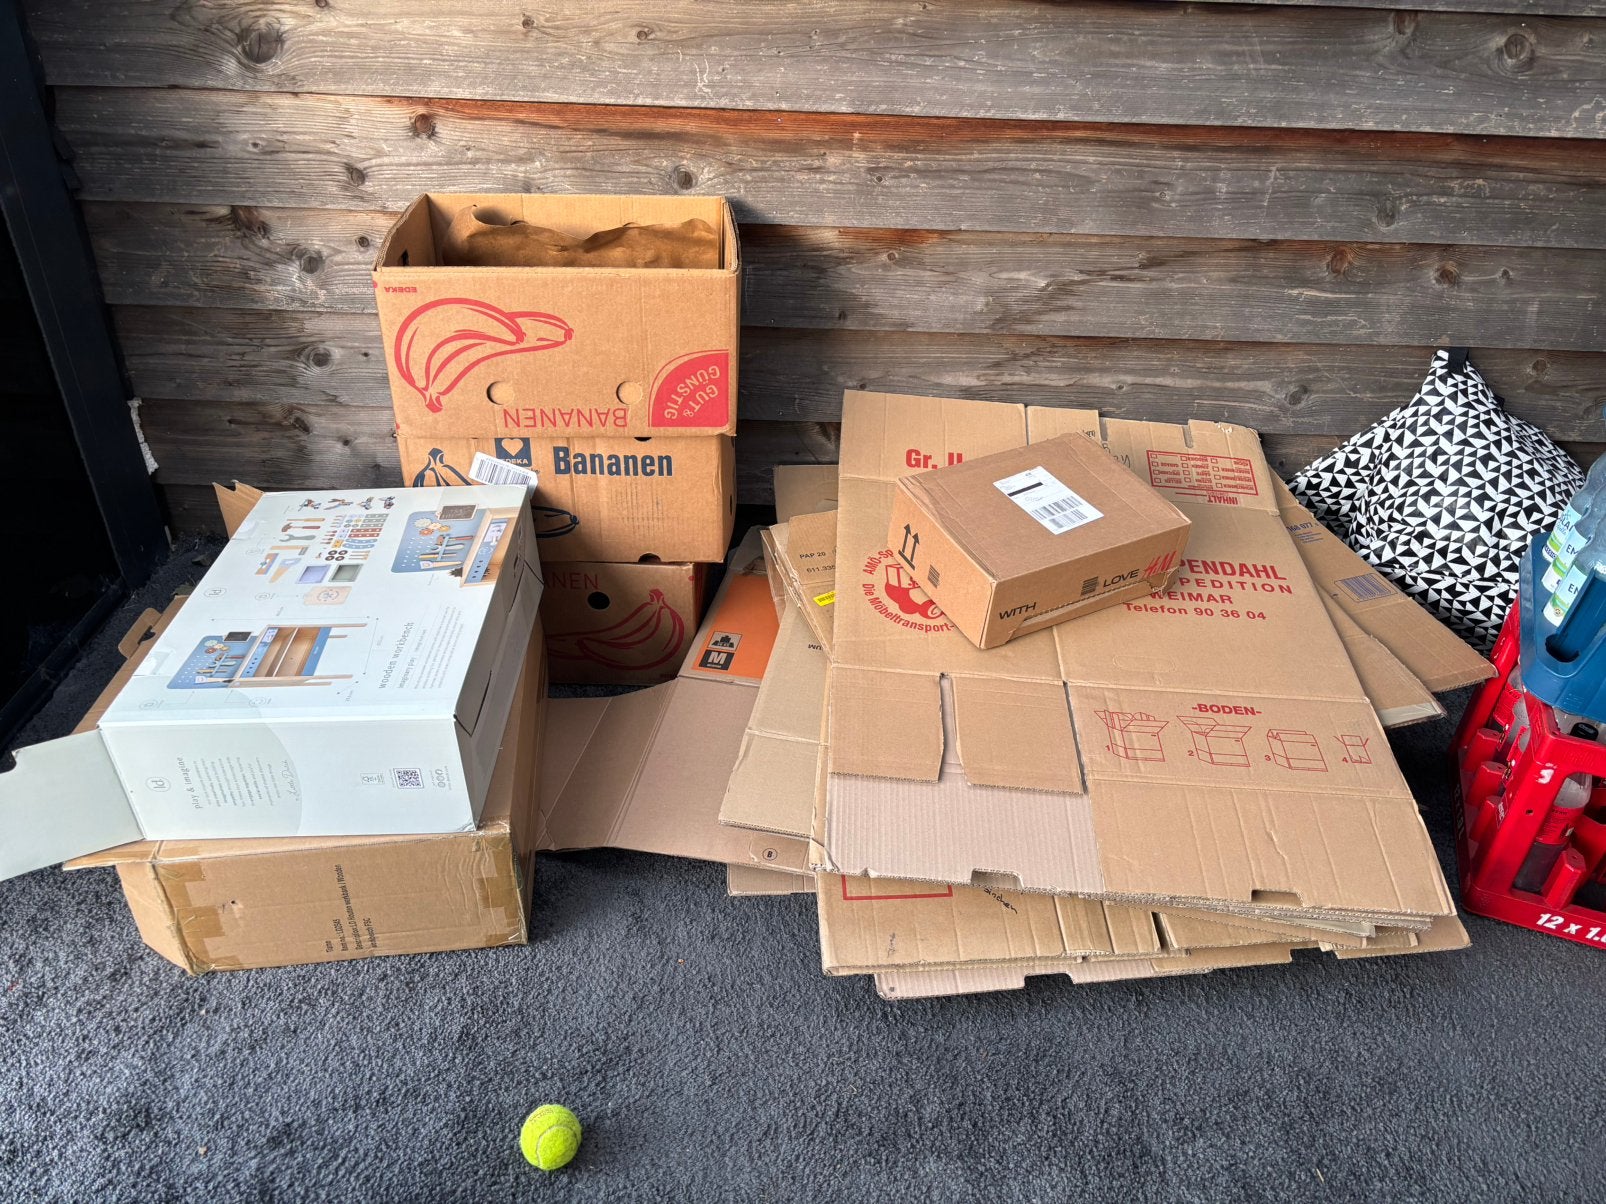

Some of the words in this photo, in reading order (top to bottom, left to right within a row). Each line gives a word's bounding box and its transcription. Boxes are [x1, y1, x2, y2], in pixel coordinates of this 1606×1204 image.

[664, 365, 720, 420] GÜNSTIG
[503, 407, 628, 429] BANANEN
[552, 445, 673, 477] Bananen
[905, 448, 938, 470] Gr.
[1207, 494, 1238, 505] INHALT
[1103, 568, 1140, 588] LOVE
[1179, 577, 1293, 595] PEDITION
[862, 583, 875, 596] Die
[1151, 591, 1234, 605] WEIMAR
[999, 602, 1036, 620] WITH
[1123, 602, 1188, 616] Telefon
[1194, 607, 1215, 617] 90
[1220, 609, 1241, 619] 36
[1246, 610, 1267, 620] 04
[707, 651, 727, 665] M
[1187, 749, 1195, 757] 2
[176, 757, 192, 785] imagine
[189, 795, 203, 810] play
[1536, 913, 1565, 930] 12
[1563, 920, 1584, 935] x
